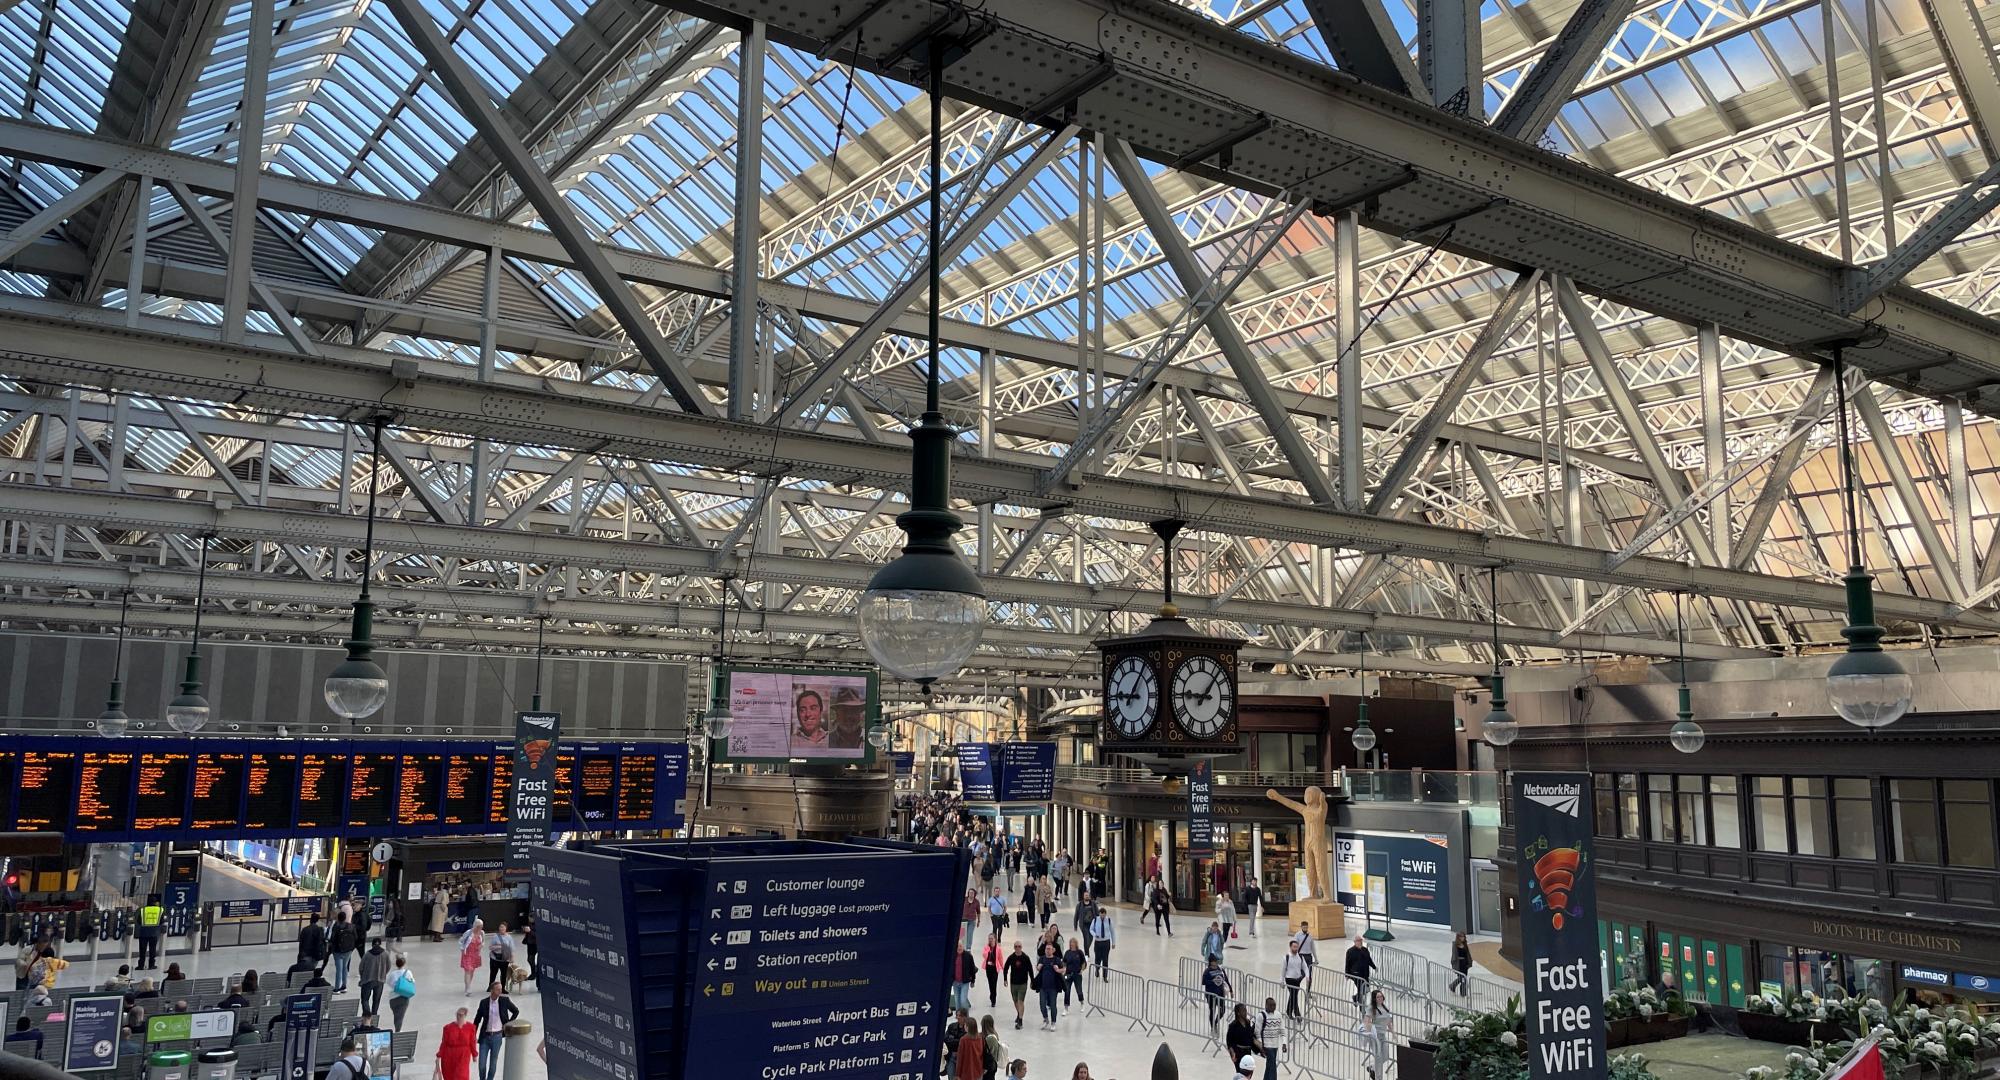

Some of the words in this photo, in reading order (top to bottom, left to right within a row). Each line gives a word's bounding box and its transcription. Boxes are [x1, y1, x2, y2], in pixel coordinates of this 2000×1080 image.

[518, 777, 548, 791] Fast
[1191, 781, 1208, 792] Fast
[1523, 783, 1580, 795] NetworkRail
[516, 793, 547, 806] Free
[1191, 793, 1208, 803] Free
[516, 808, 546, 819] WiFi
[1192, 804, 1209, 813] WiFi
[1213, 806, 1239, 814] ONAS
[1337, 841, 1351, 851] TO
[462, 860, 503, 869] Information
[1338, 853, 1356, 863] LET
[547, 866, 556, 876] Left
[556, 868, 572, 884] luggage
[1412, 860, 1436, 874] WiFi
[766, 879, 824, 892] Customer
[826, 877, 865, 891] lounge
[175, 891, 186, 905] 3
[546, 888, 558, 902] Cycle
[558, 891, 568, 903] Park
[568, 893, 588, 908] Platform
[588, 898, 595, 910] 15
[763, 904, 788, 917] Left
[790, 903, 836, 918] luggage
[838, 904, 855, 913] Lost
[856, 903, 890, 914] property
[560, 915, 570, 928] level
[570, 918, 585, 931] station
[759, 929, 796, 942] Toilets
[798, 927, 819, 939] and
[822, 926, 868, 938] showers
[1812, 920, 1853, 937] BOOTS
[1855, 926, 1886, 942] THE
[1889, 930, 1961, 953] CHEMISTS
[580, 943, 596, 958] Airport
[596, 948, 606, 961] Bus
[757, 953, 800, 967] Station
[803, 949, 858, 965] reception
[1535, 957, 1589, 992] Fast
[1903, 966, 1948, 984] pharmacy
[755, 979, 783, 994] Way
[785, 977, 808, 990] out
[828, 980, 848, 988] Union
[849, 978, 870, 986] Street
[557, 991, 572, 1008] Tickets
[572, 1000, 581, 1011] and
[581, 1001, 594, 1017] Travel
[595, 1006, 611, 1024] Centre
[771, 1019, 801, 1029] Waterloo
[802, 1016, 822, 1025] Street
[827, 1008, 868, 1023] Airport
[870, 1006, 890, 1018] Bus
[1538, 999, 1591, 1034] Free
[595, 1030, 613, 1049] Tickets
[773, 1042, 801, 1053] Platform
[814, 1035, 839, 1049] NCP
[841, 1033, 860, 1045] Car
[863, 1029, 887, 1043] Park
[546, 1031, 557, 1047] Taxis
[557, 1040, 566, 1051] and
[566, 1040, 584, 1060] Glasgow
[585, 1049, 602, 1068] Station
[602, 1058, 613, 1073] Link
[1540, 1038, 1593, 1074] WiFi
[762, 1064, 797, 1080] Cycle
[799, 1061, 826, 1075] Park
[828, 1055, 880, 1071] Platform
[882, 1052, 895, 1064] 15
